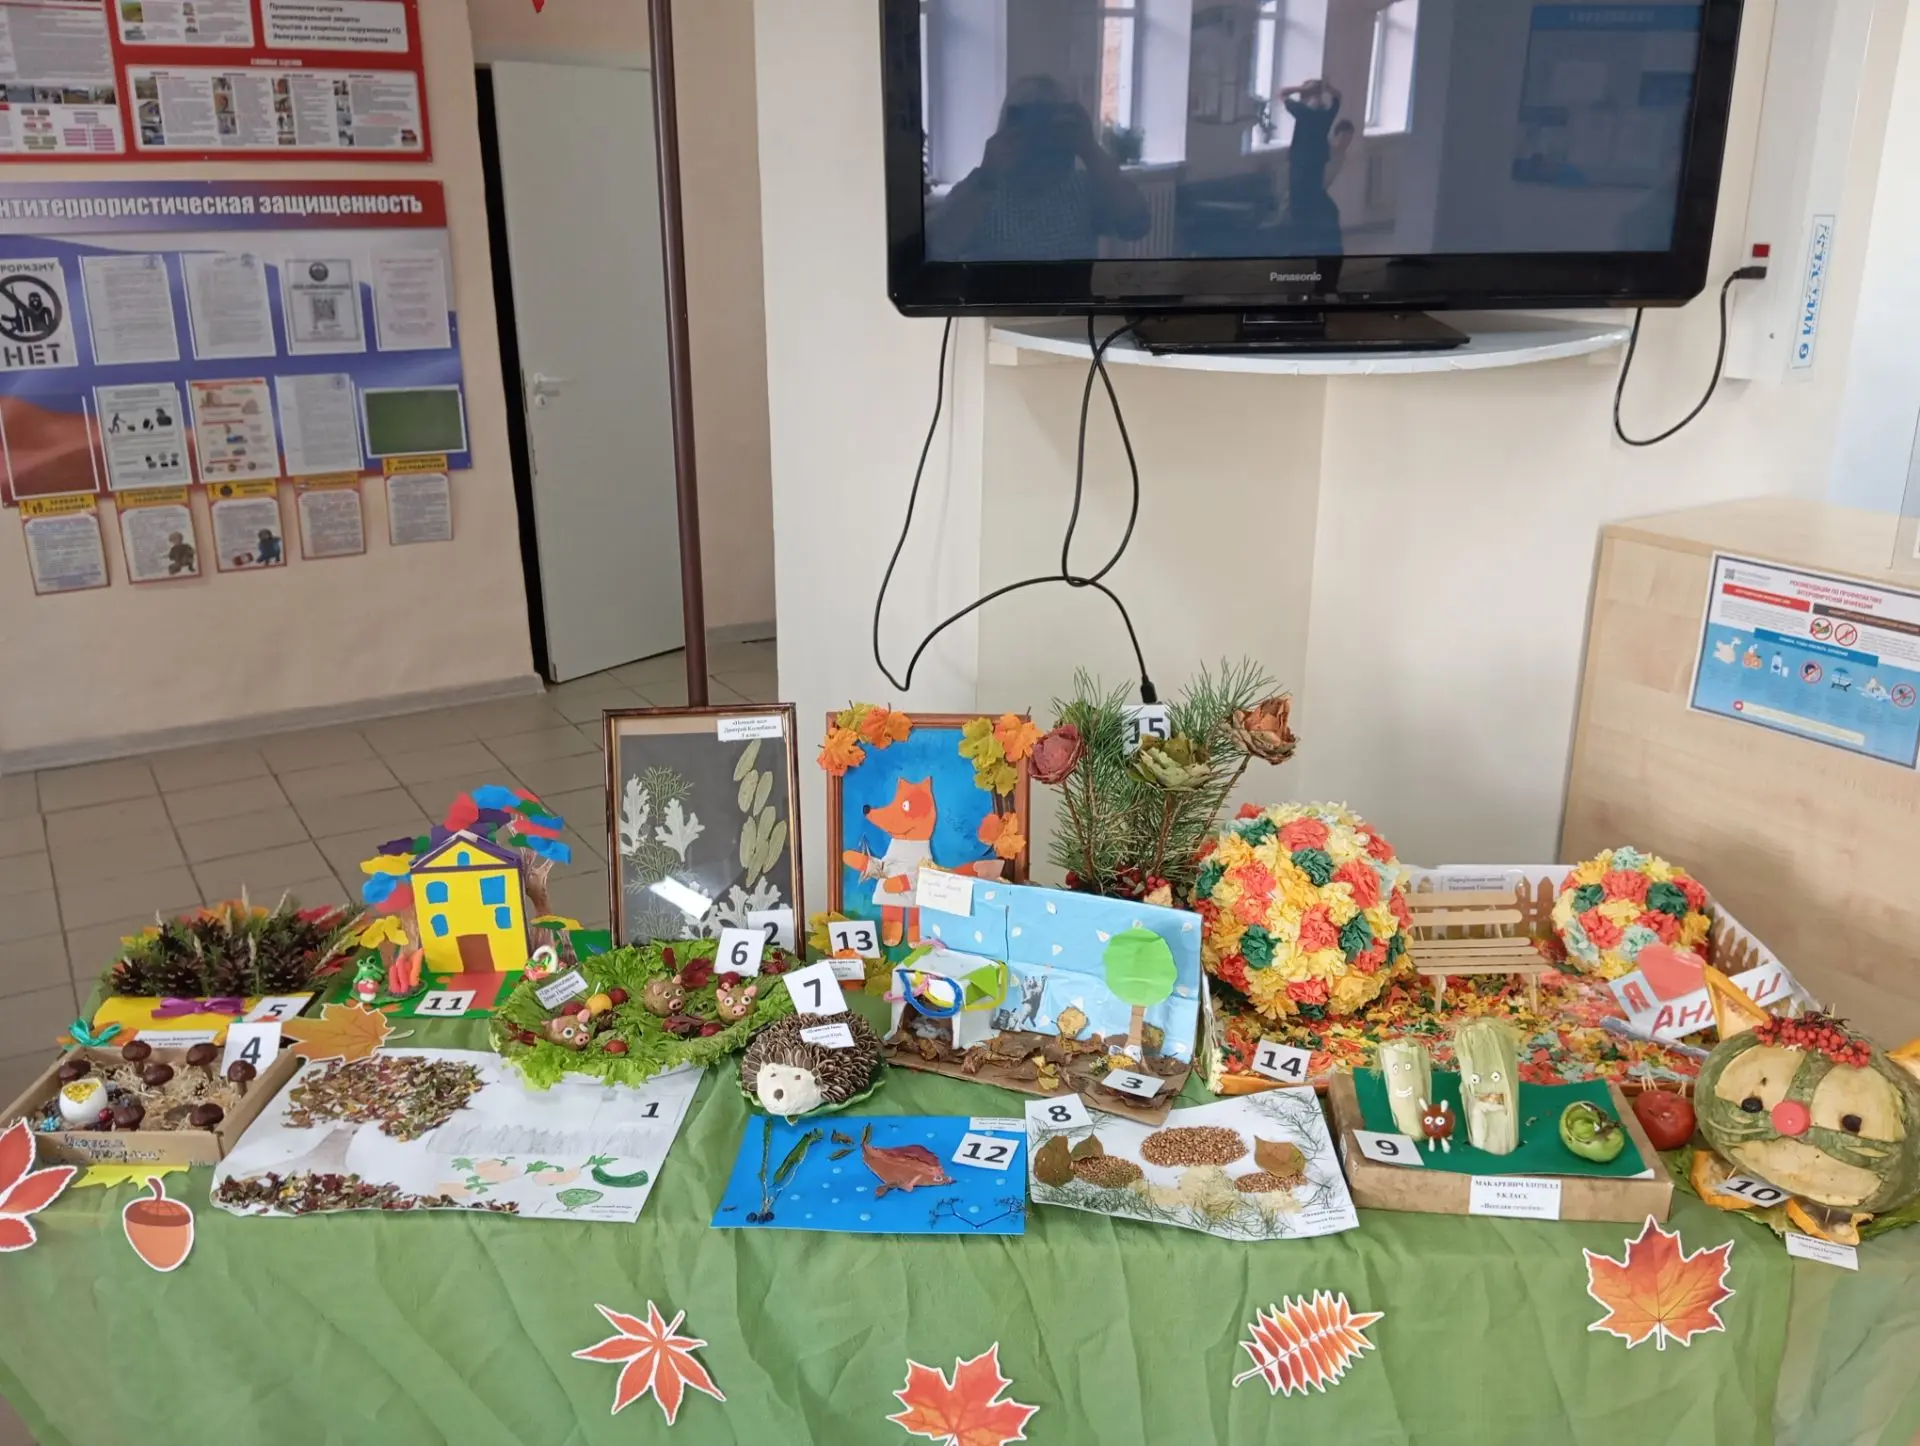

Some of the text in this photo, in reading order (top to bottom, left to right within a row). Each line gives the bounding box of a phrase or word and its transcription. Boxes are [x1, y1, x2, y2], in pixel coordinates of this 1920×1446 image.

[259, 195, 423, 216] защищенность
[1269, 271, 1322, 281] Panasonic
[4, 343, 60, 367] НЕТ
[1128, 717, 1166, 745] 15
[762, 921, 781, 947] 2
[836, 929, 874, 952] 13
[730, 940, 749, 966] 6
[423, 996, 463, 1011] 11
[802, 977, 823, 1008] 7
[1622, 980, 1652, 1014] Я
[268, 1003, 288, 1017] 5
[240, 1036, 262, 1065] 4
[1259, 1050, 1302, 1077] 14
[1121, 1077, 1144, 1090] 3
[641, 1102, 660, 1119] 1
[1048, 1105, 1072, 1123] 8
[962, 1142, 1008, 1164] 12
[1375, 1140, 1400, 1157] 9
[1725, 1179, 1781, 1202] 10
